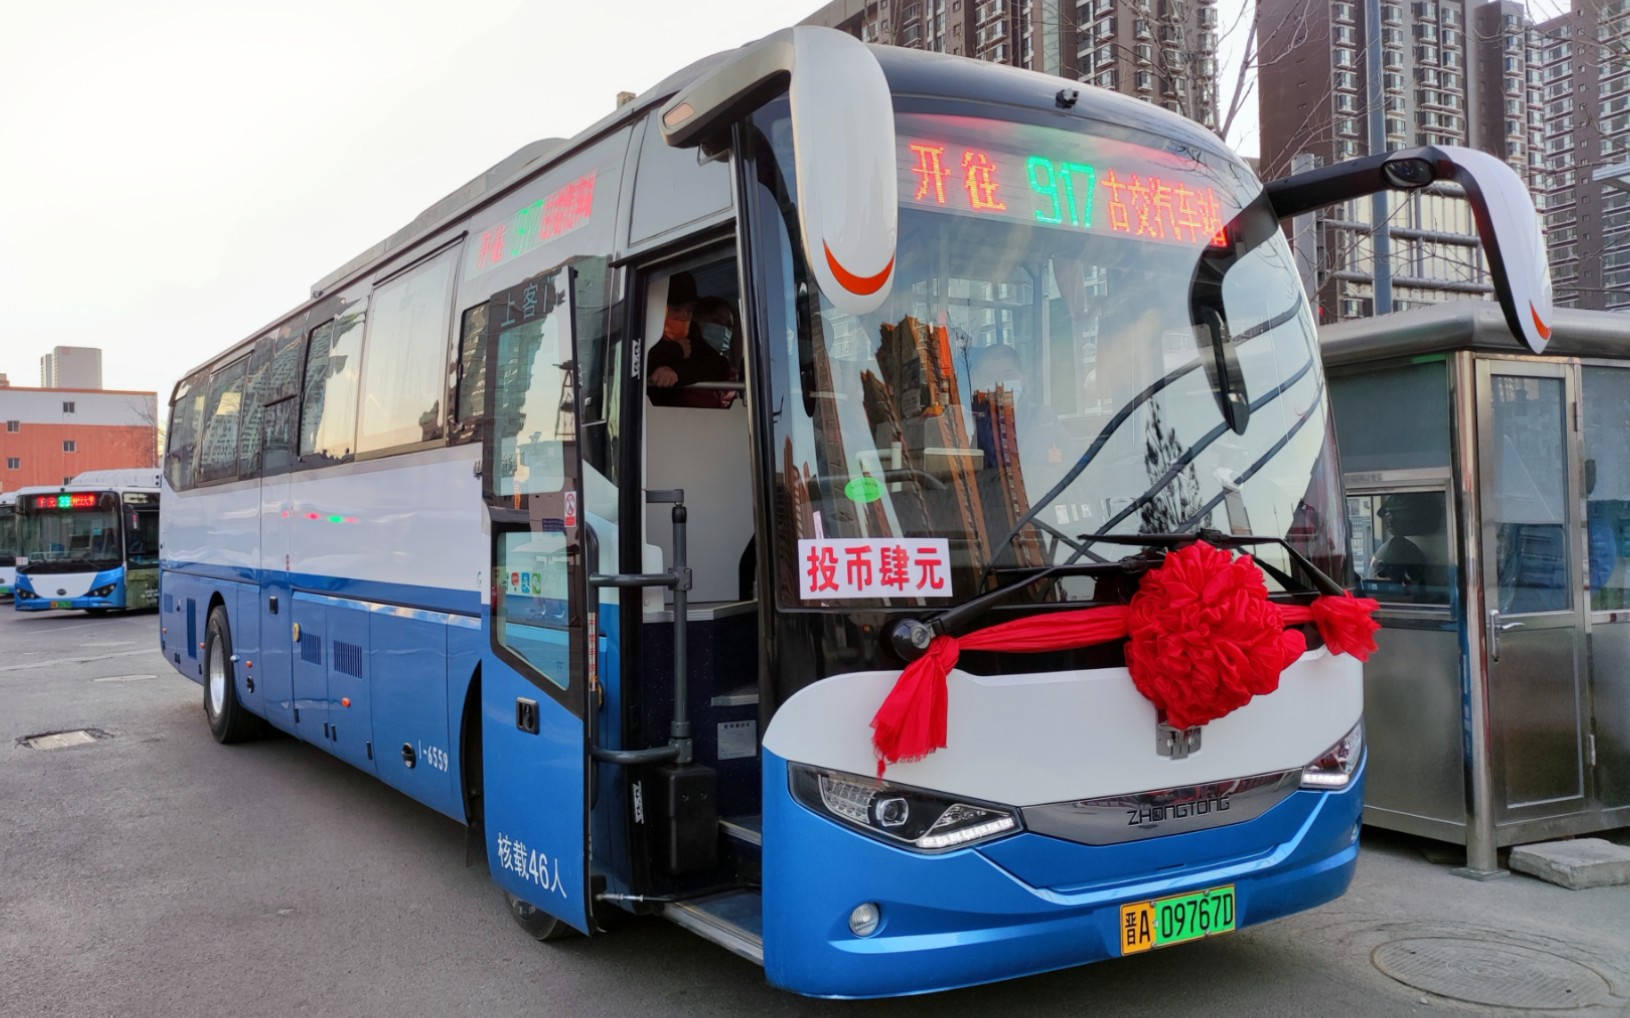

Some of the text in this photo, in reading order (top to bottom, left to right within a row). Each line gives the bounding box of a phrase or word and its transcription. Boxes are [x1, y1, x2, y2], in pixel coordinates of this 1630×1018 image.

[910, 143, 1007, 211] 开往
[1026, 155, 1096, 228] 917
[806, 544, 945, 592] 投币肆元
[1127, 796, 1230, 826] ZHONGTONG
[497, 832, 567, 899] 核载46人
